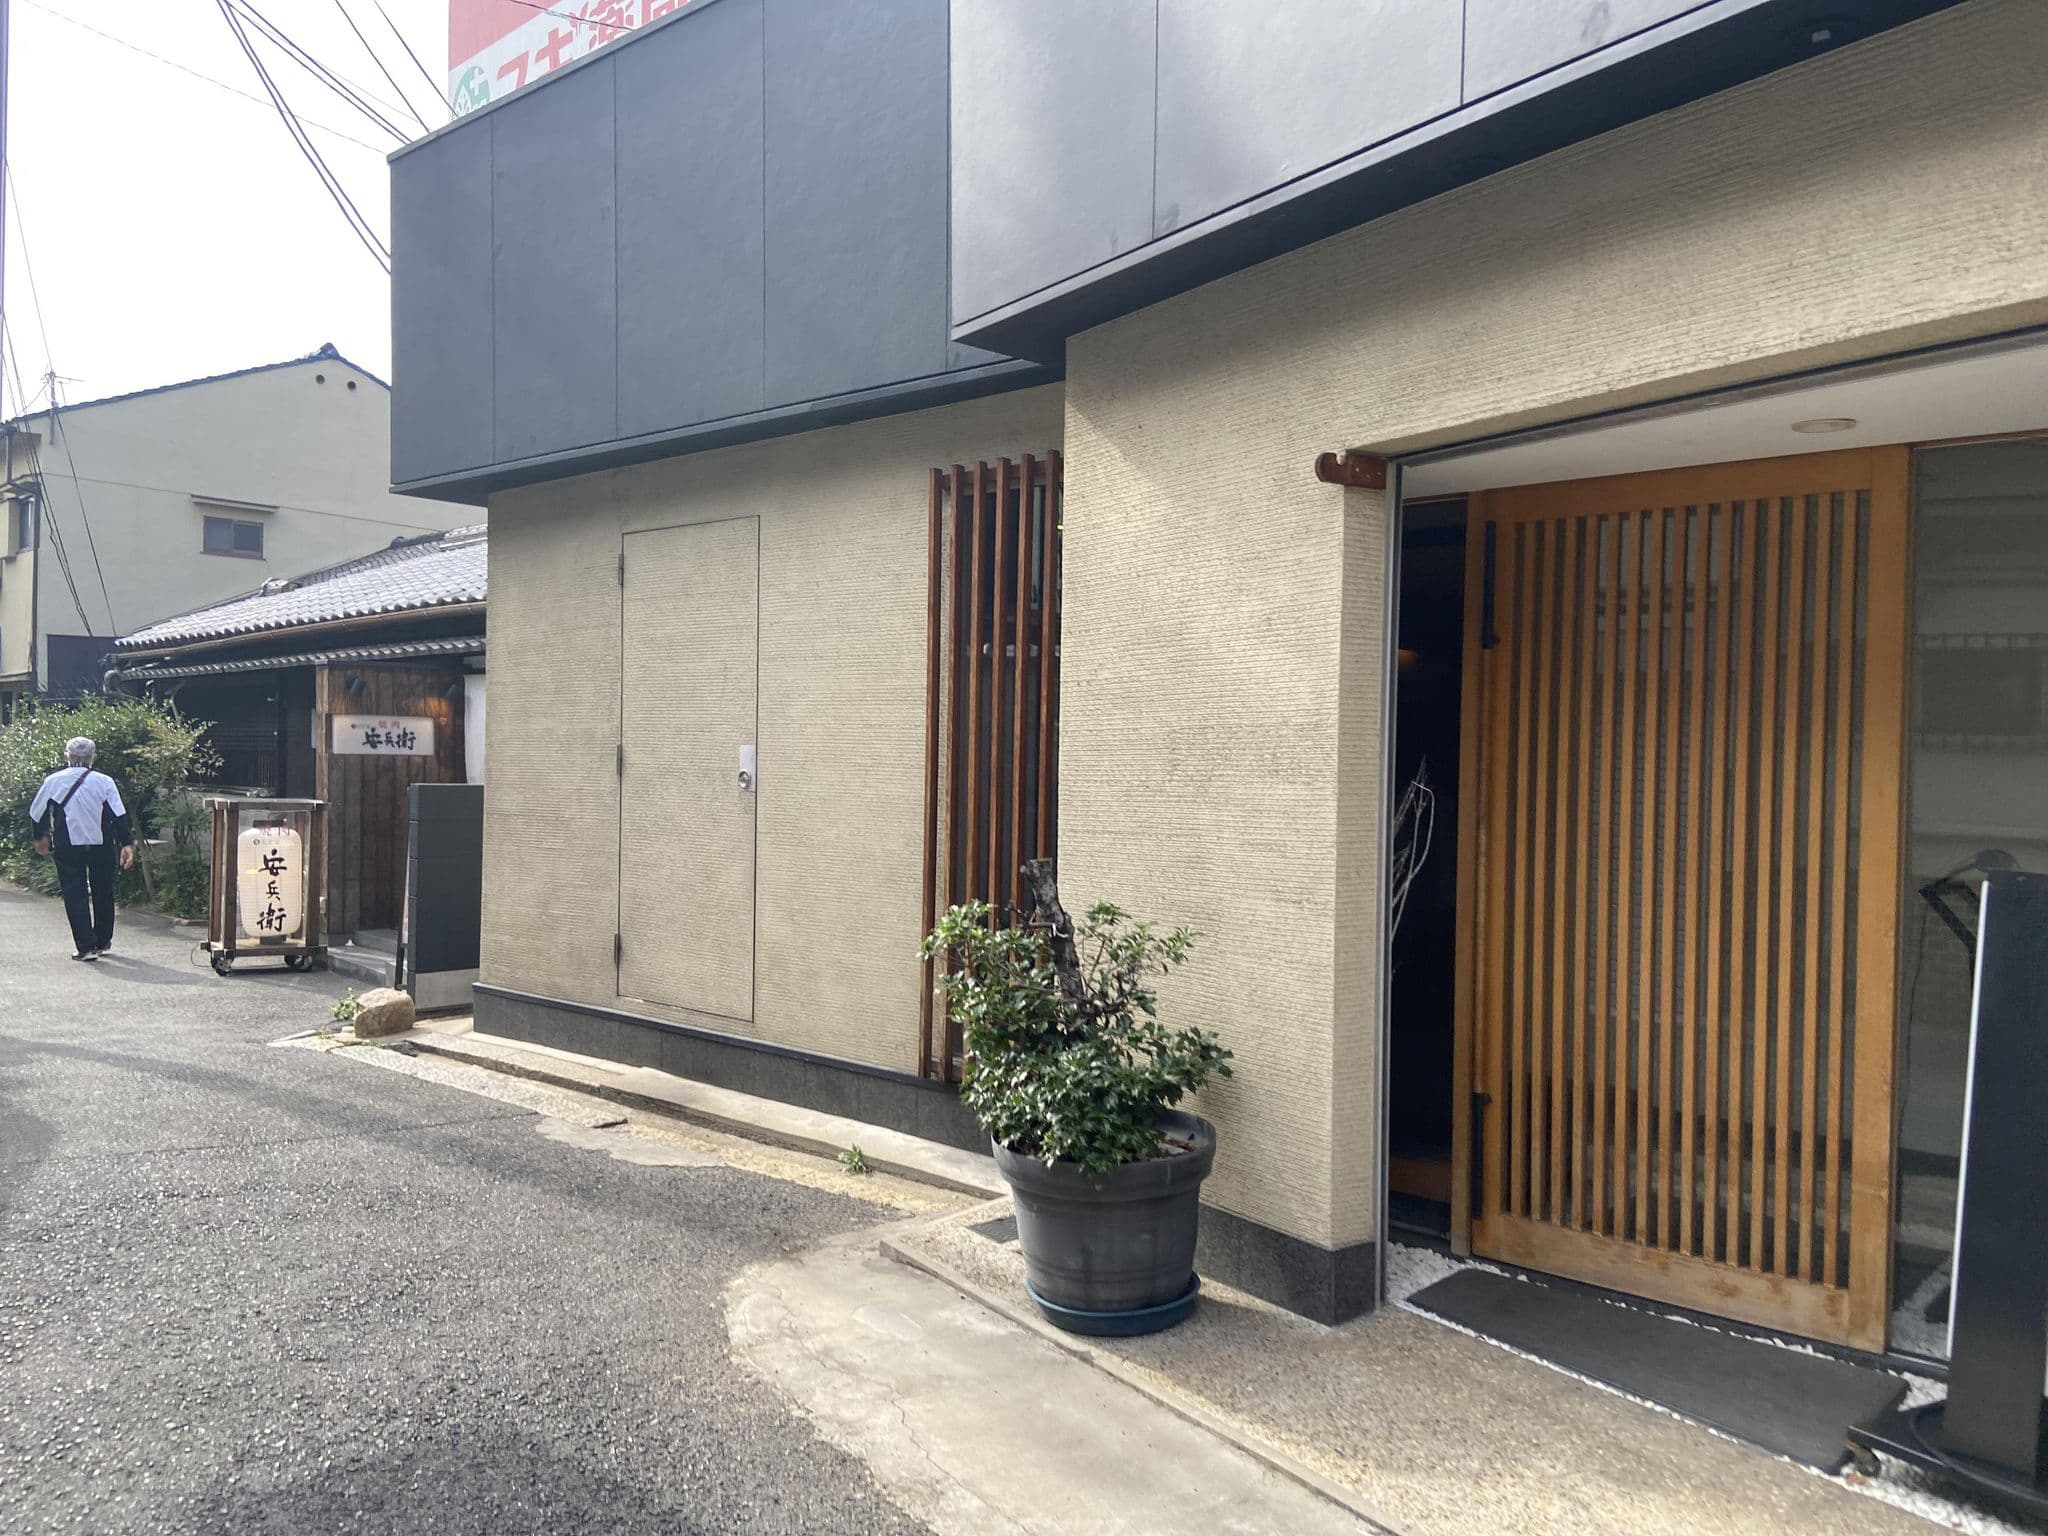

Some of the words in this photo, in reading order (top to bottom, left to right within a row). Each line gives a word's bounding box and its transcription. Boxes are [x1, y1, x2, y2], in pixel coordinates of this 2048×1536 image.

[362, 727, 417, 750] 安兵衛
[256, 848, 288, 932] 安兵衛
